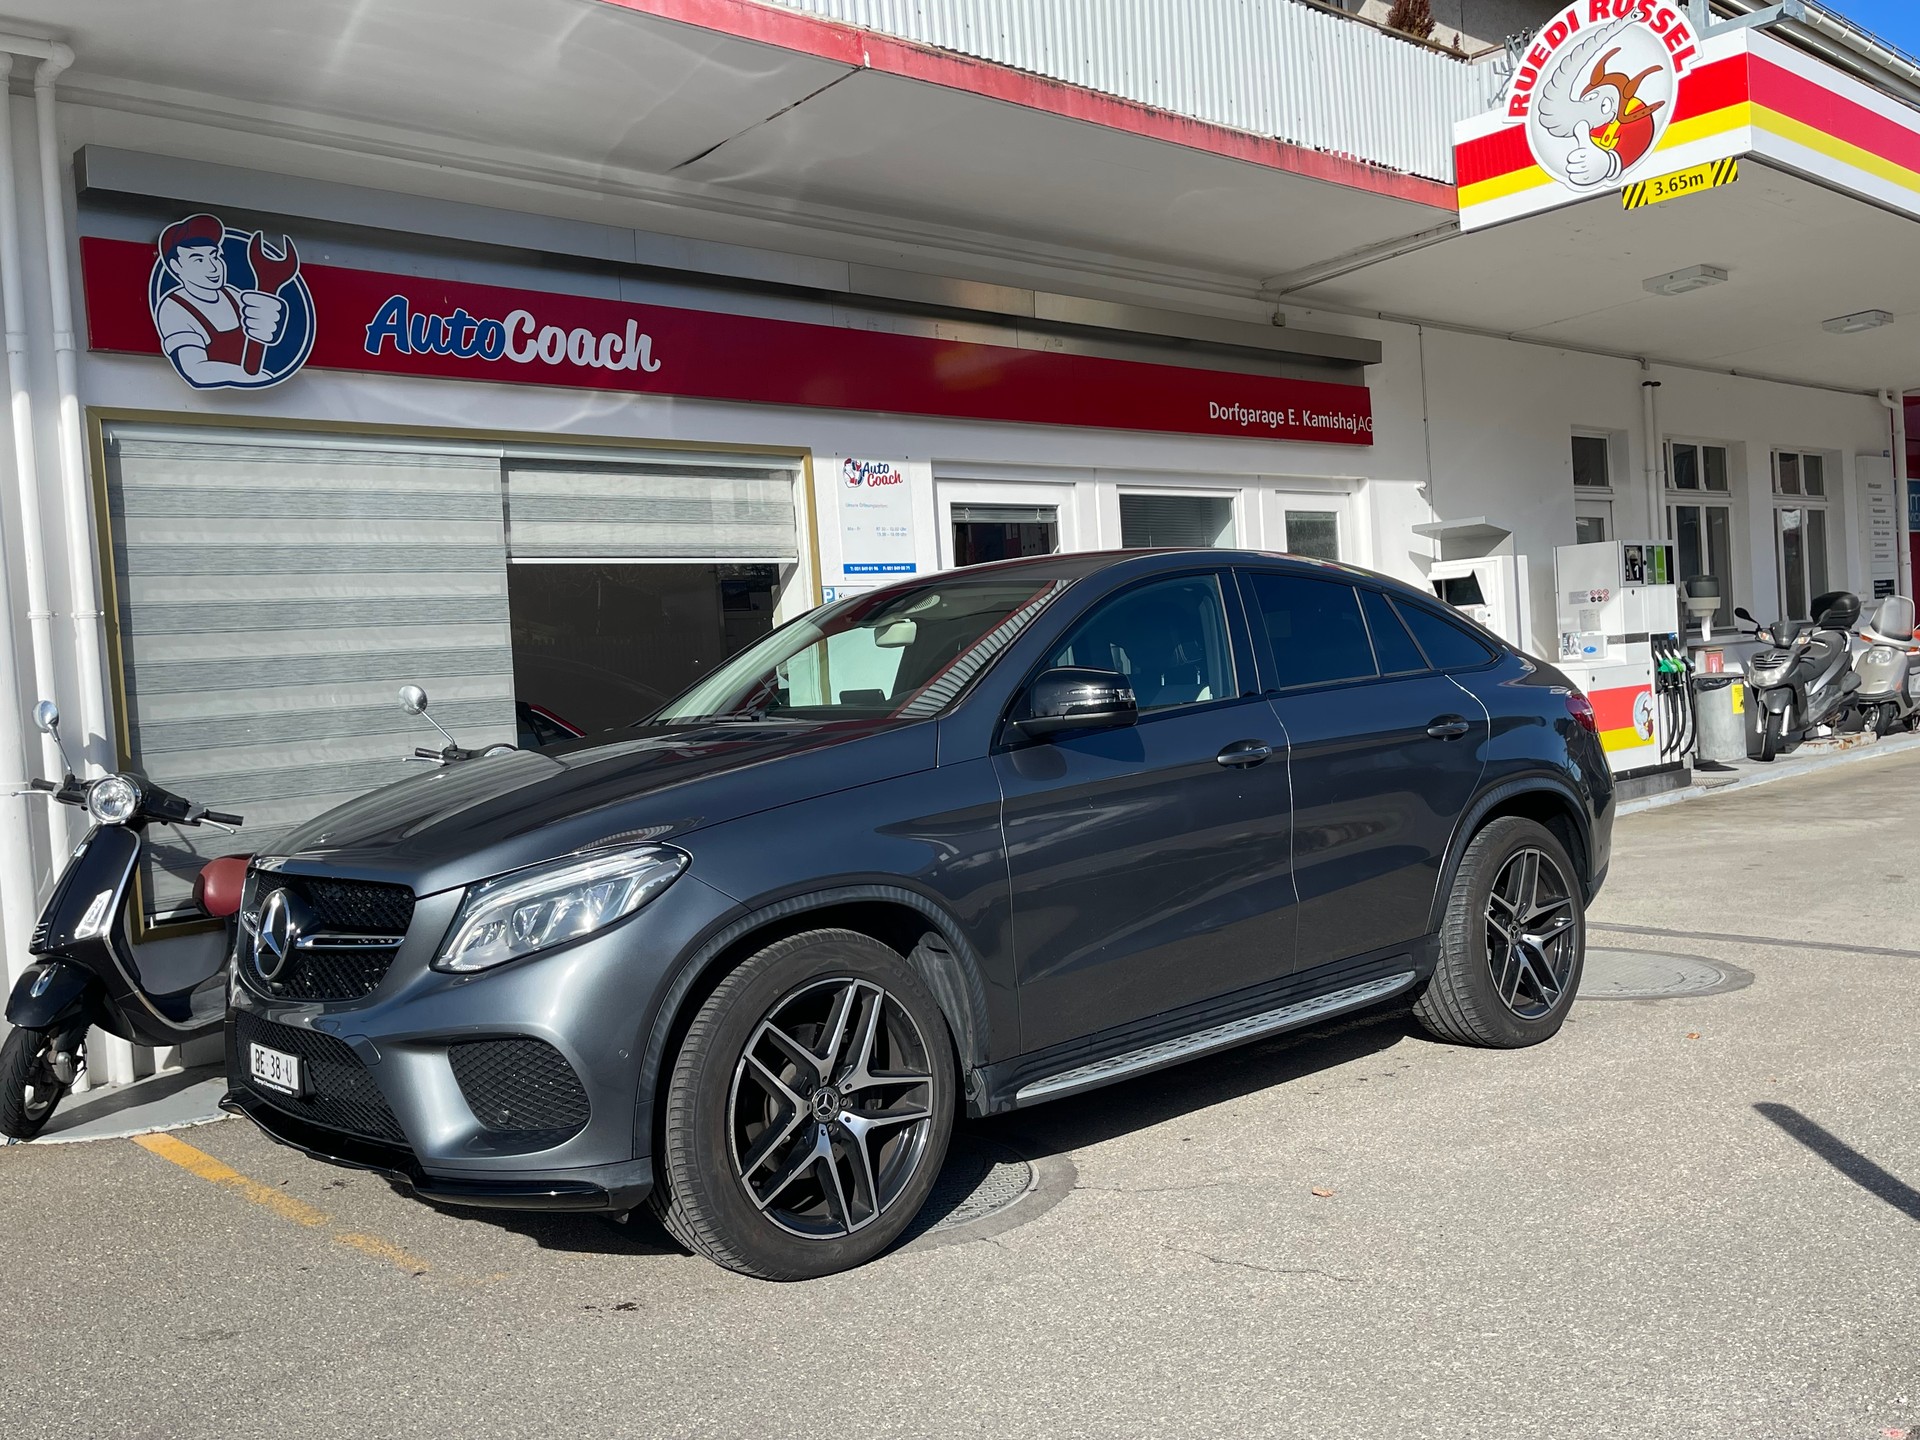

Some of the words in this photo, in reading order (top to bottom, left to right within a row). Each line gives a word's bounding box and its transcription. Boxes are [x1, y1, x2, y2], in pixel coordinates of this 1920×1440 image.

[1508, 9, 1580, 117] RUEDI
[1654, 173, 1705, 197] 3.65m
[1209, 401, 1285, 428] Dorfgarage
[1288, 408, 1299, 426] E.
[862, 461, 890, 477] Auto
[867, 469, 904, 487] Coach
